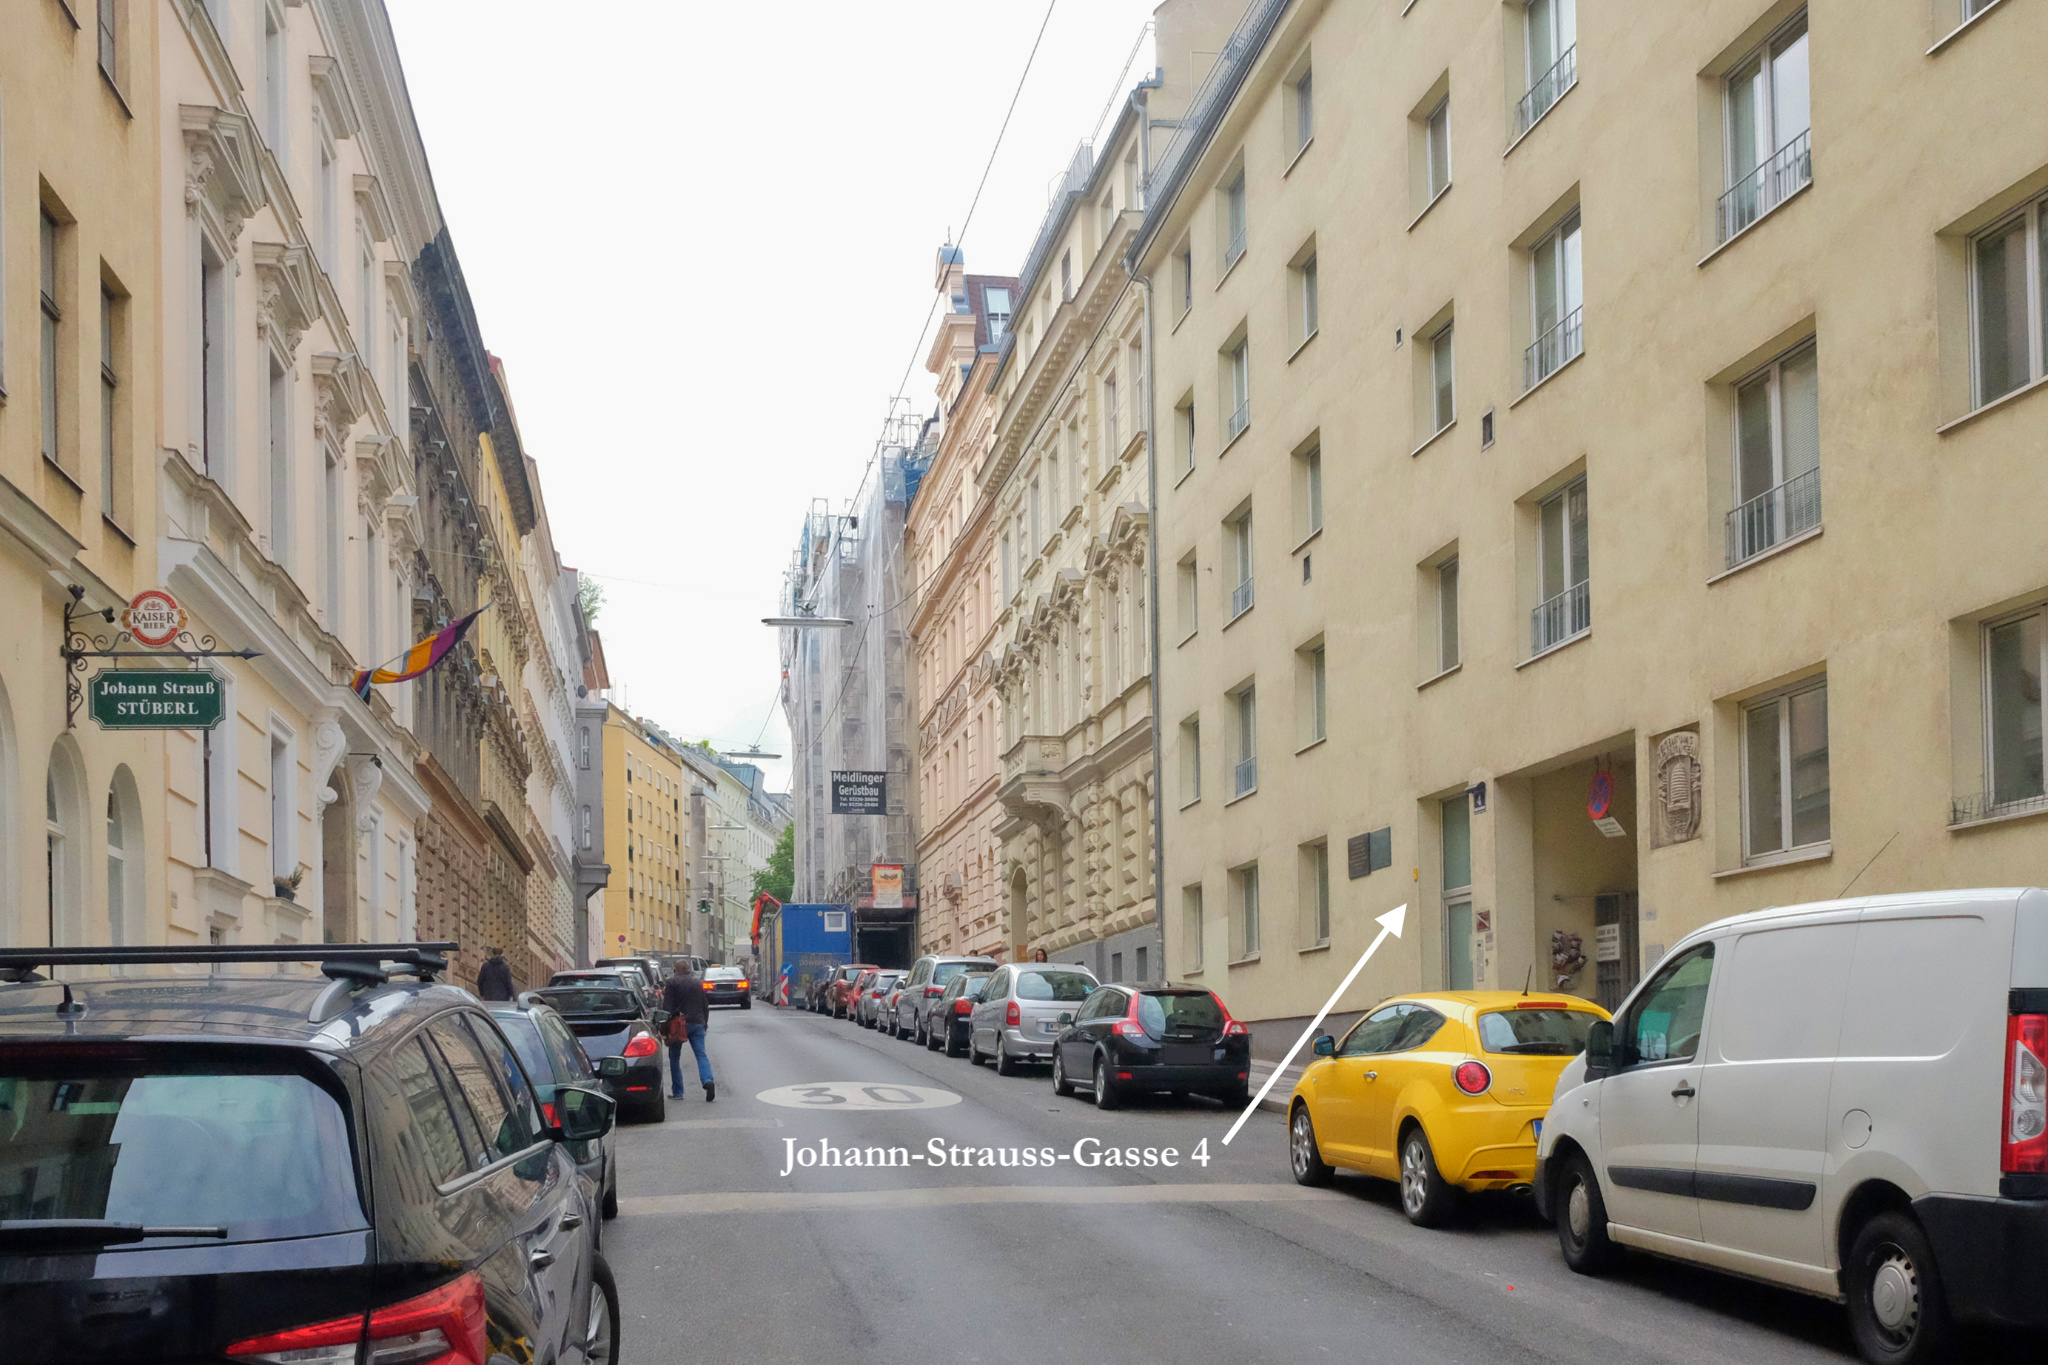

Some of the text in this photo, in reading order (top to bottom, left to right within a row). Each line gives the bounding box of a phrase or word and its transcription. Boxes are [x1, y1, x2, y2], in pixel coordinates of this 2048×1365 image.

[133, 612, 175, 624] KAISER
[100, 681, 215, 696] Johann Strauß
[117, 699, 199, 715] STÜBERL
[833, 772, 884, 785] Meidlinger
[839, 785, 879, 796] Gerüstbau
[1476, 794, 1482, 806] 4
[792, 1087, 925, 1105] 30
